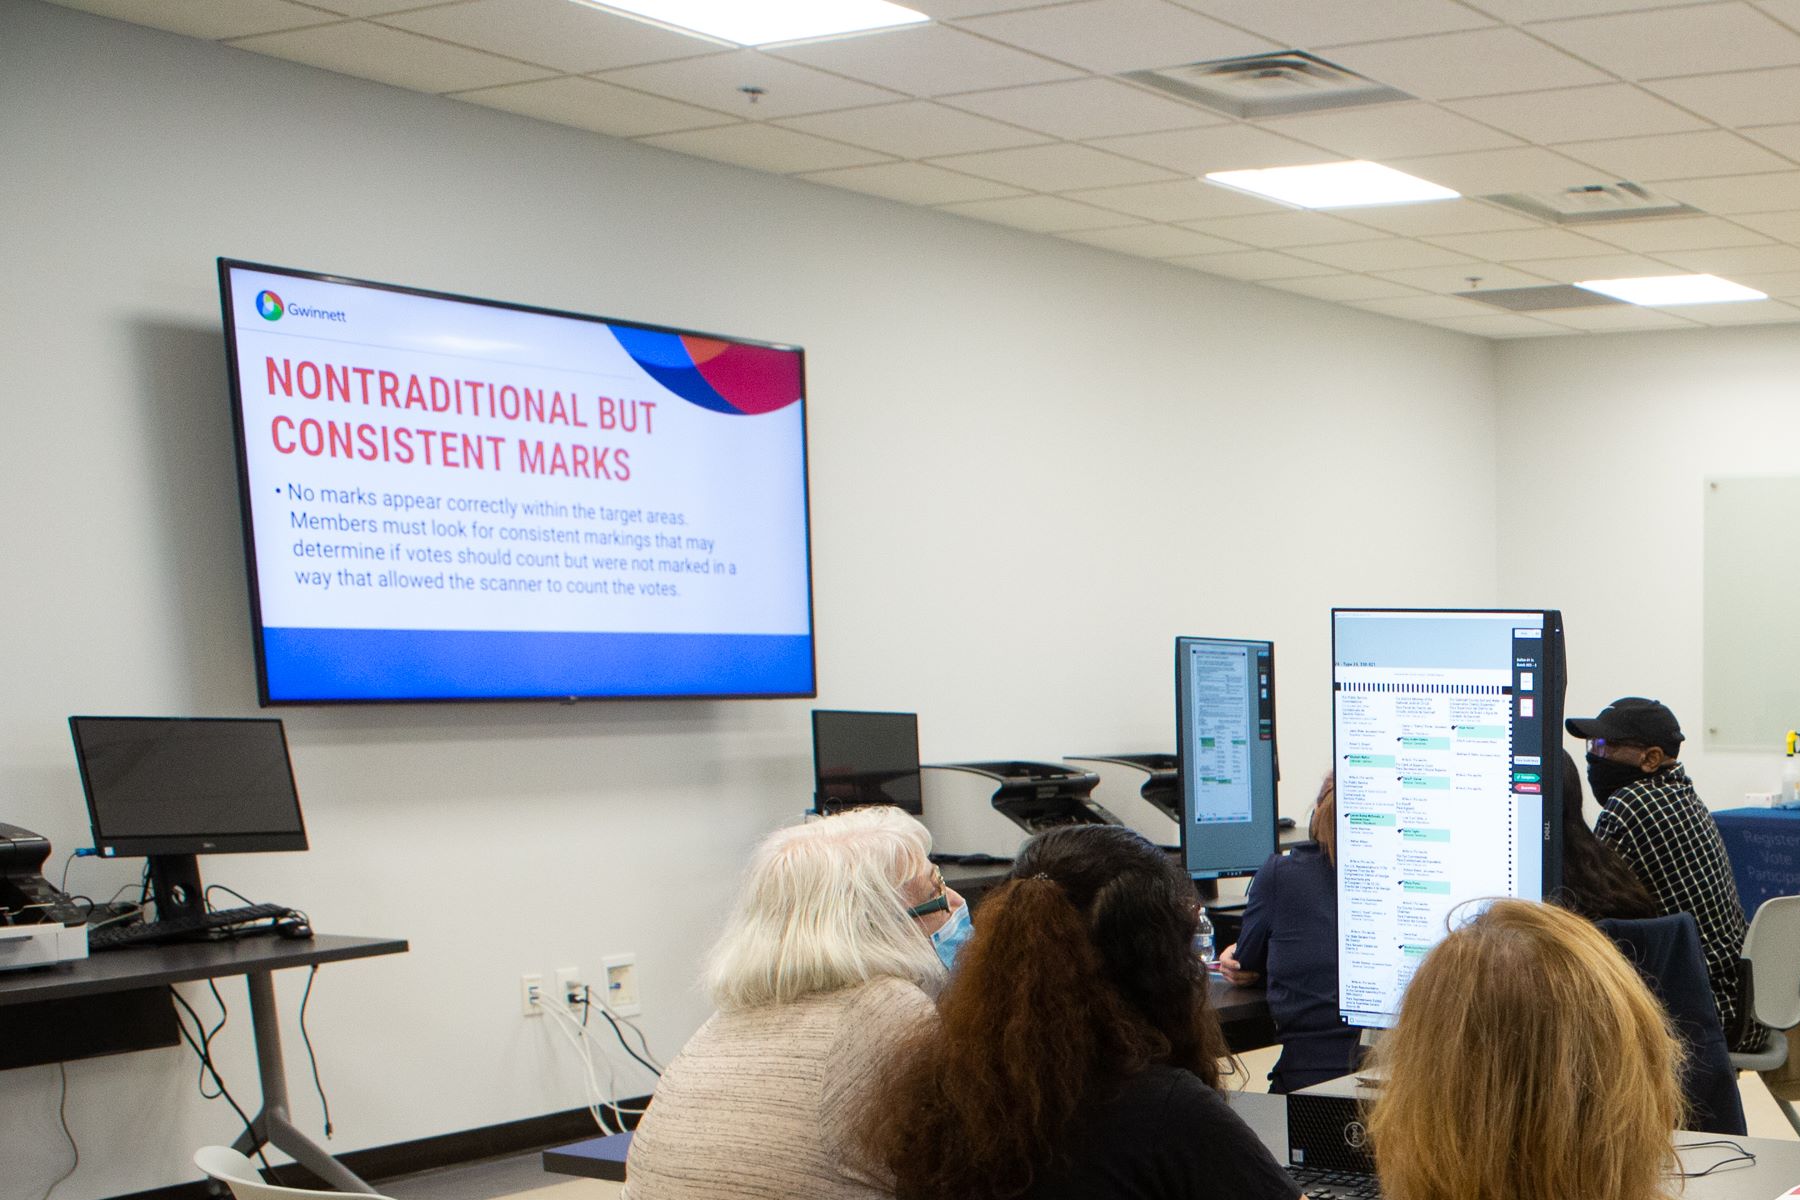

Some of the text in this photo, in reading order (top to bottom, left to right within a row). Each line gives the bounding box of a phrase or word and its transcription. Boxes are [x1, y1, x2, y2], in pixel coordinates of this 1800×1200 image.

[288, 303, 346, 322] Gwinnett
[266, 356, 656, 434] NONTRADITIONAL BUT
[271, 415, 631, 482] CONSISTENT MARKS
[288, 483, 688, 526] No marks appear correctly within the target areas.
[290, 511, 715, 553] Members must look for consistent markings that may
[293, 539, 736, 575] determine if votes should count but were not marked in a
[295, 568, 680, 597] way that allowed the scanner to count the votes.
[1743, 830, 1800, 847] Register
[1762, 851, 1792, 865] Vote
